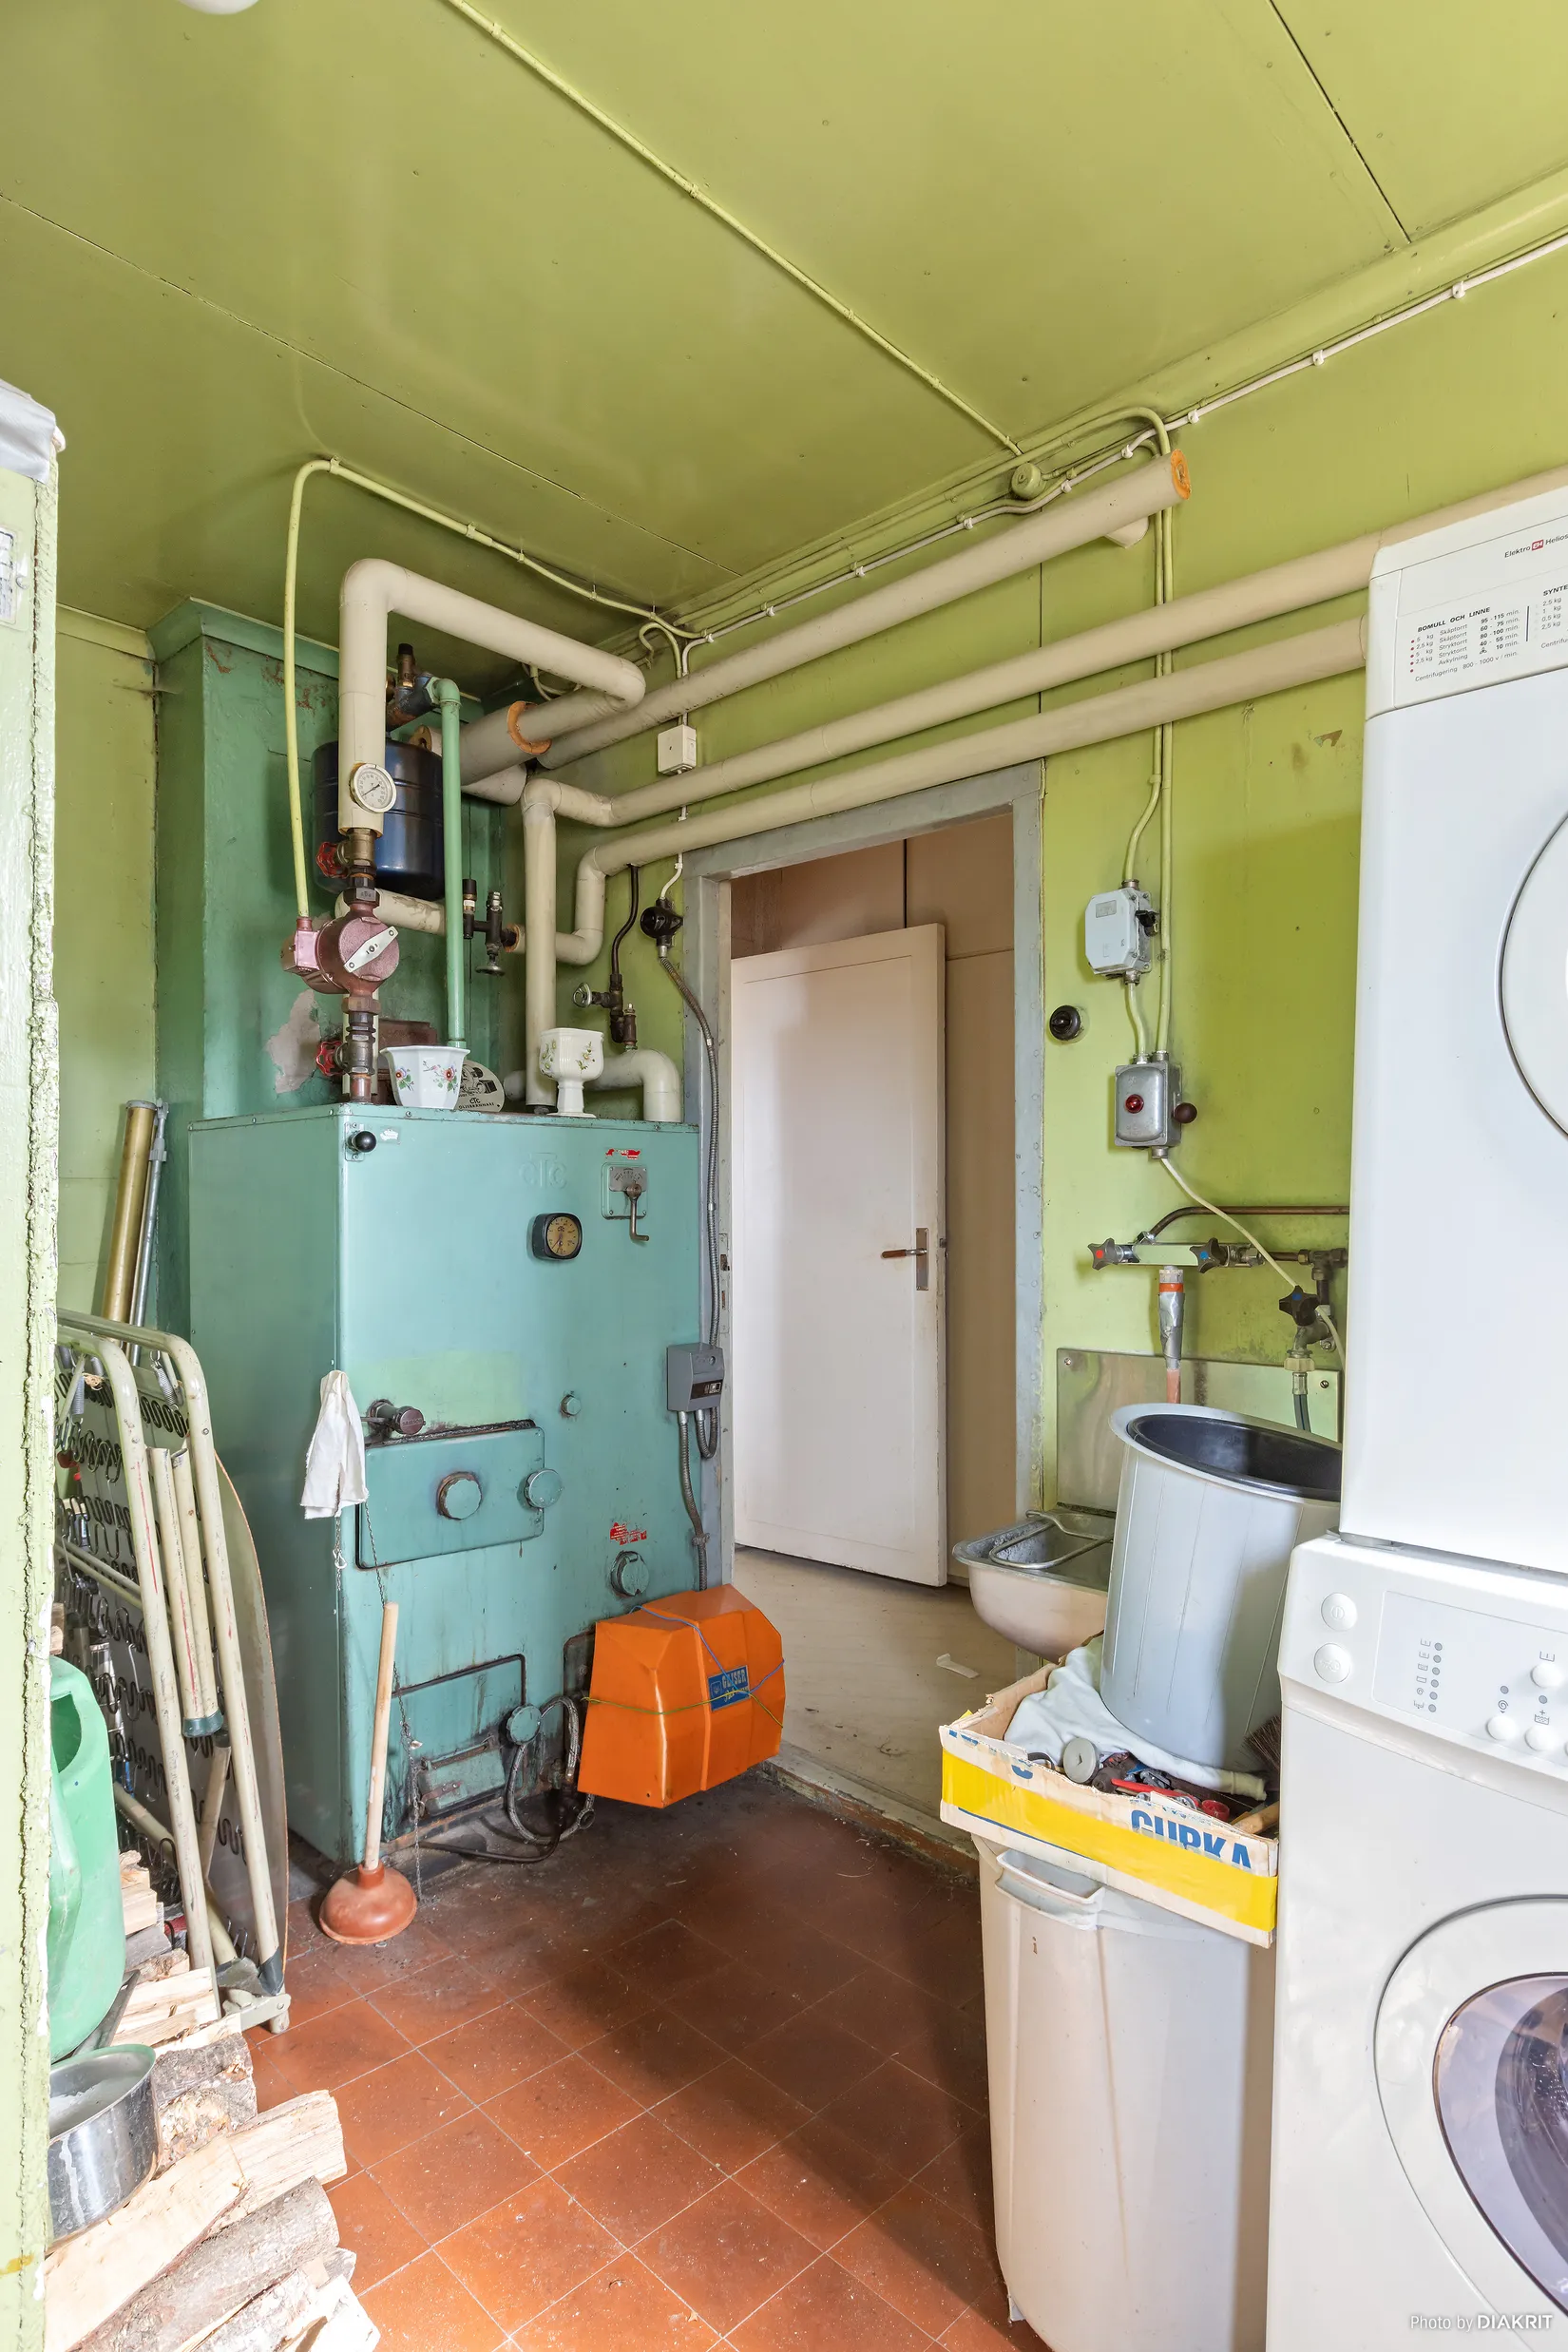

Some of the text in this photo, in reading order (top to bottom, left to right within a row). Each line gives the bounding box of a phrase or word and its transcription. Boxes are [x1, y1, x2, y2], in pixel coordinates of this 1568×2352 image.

[1504, 545, 1531, 558] Elektro
[1545, 533, 1568, 545] Helios
[1417, 607, 1491, 632] BOMULL OCH LINNE
[1438, 647, 1467, 659] Stryktorrt
[1439, 639, 1468, 651] Stryktorrt
[1415, 667, 1458, 682] Centrifugering
[1480, 656, 1494, 665] 1000
[1438, 654, 1468, 665] Avkylning
[519, 1152, 568, 1189] CTC
